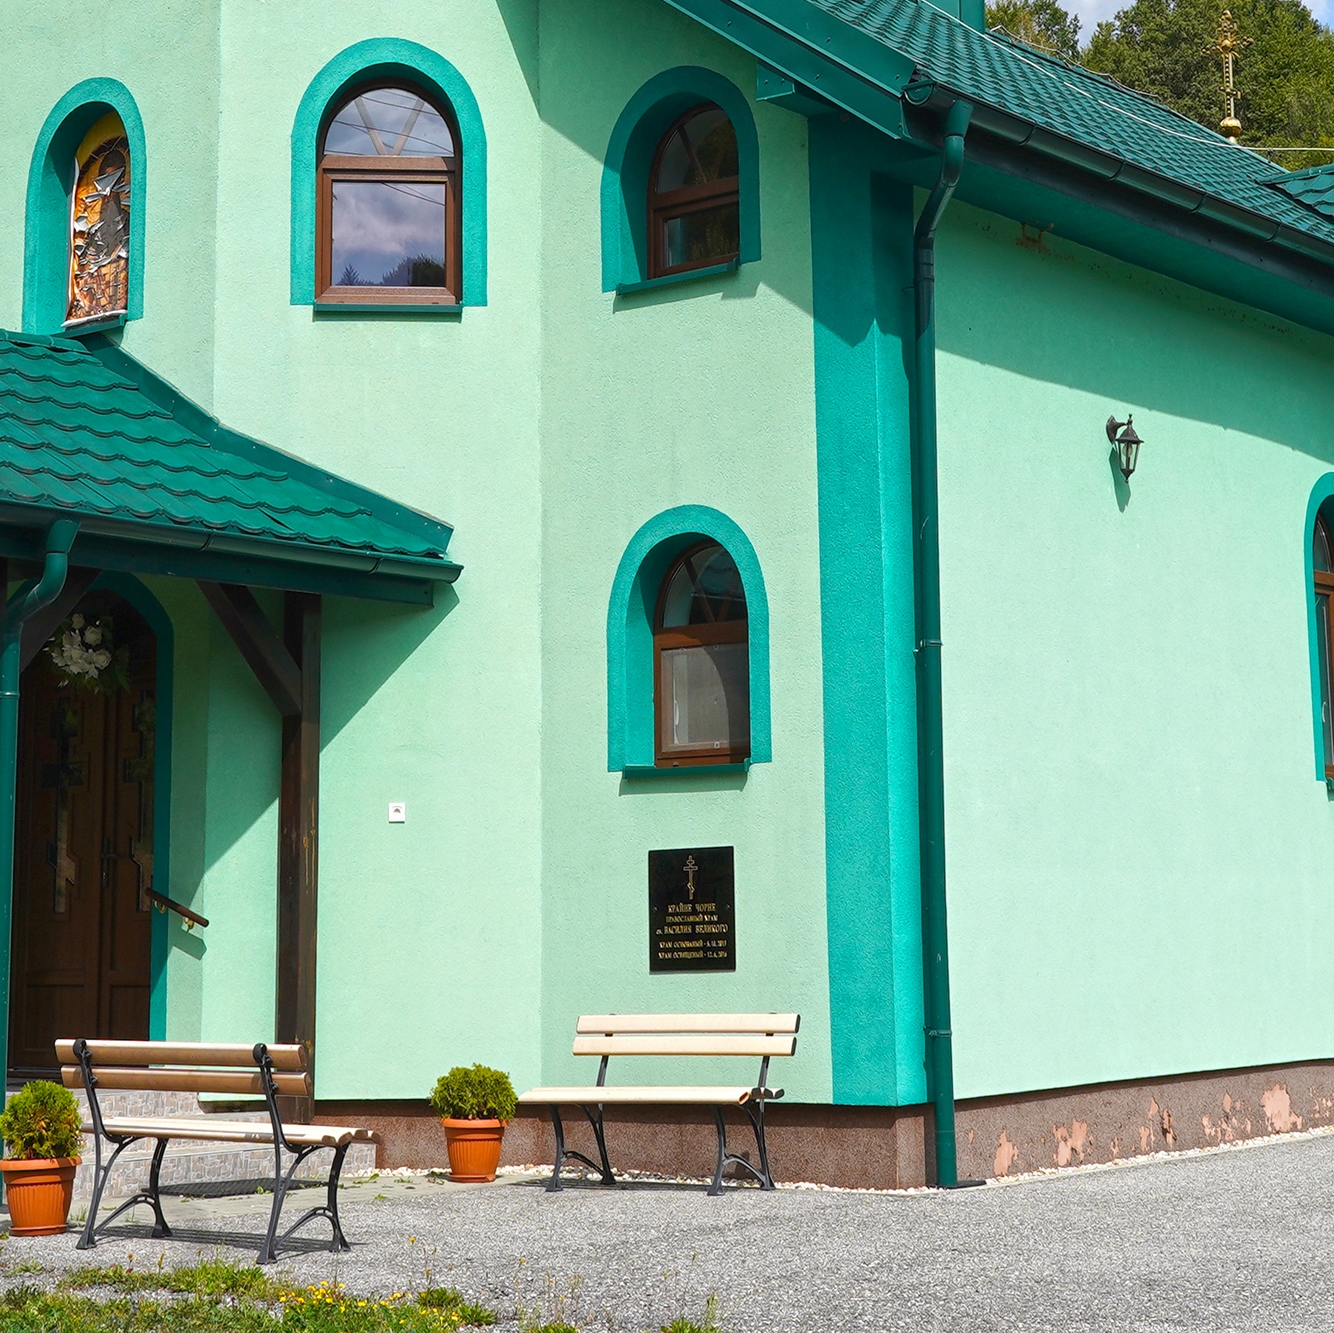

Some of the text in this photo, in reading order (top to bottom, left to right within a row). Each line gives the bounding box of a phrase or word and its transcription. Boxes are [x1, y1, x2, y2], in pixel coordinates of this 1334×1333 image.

[668, 902, 716, 913] КРАЙНЕ ЧОРНЕ
[664, 925, 692, 934] ВАСИЛИЯ
[696, 924, 728, 933] ВЕЛИКОГО
